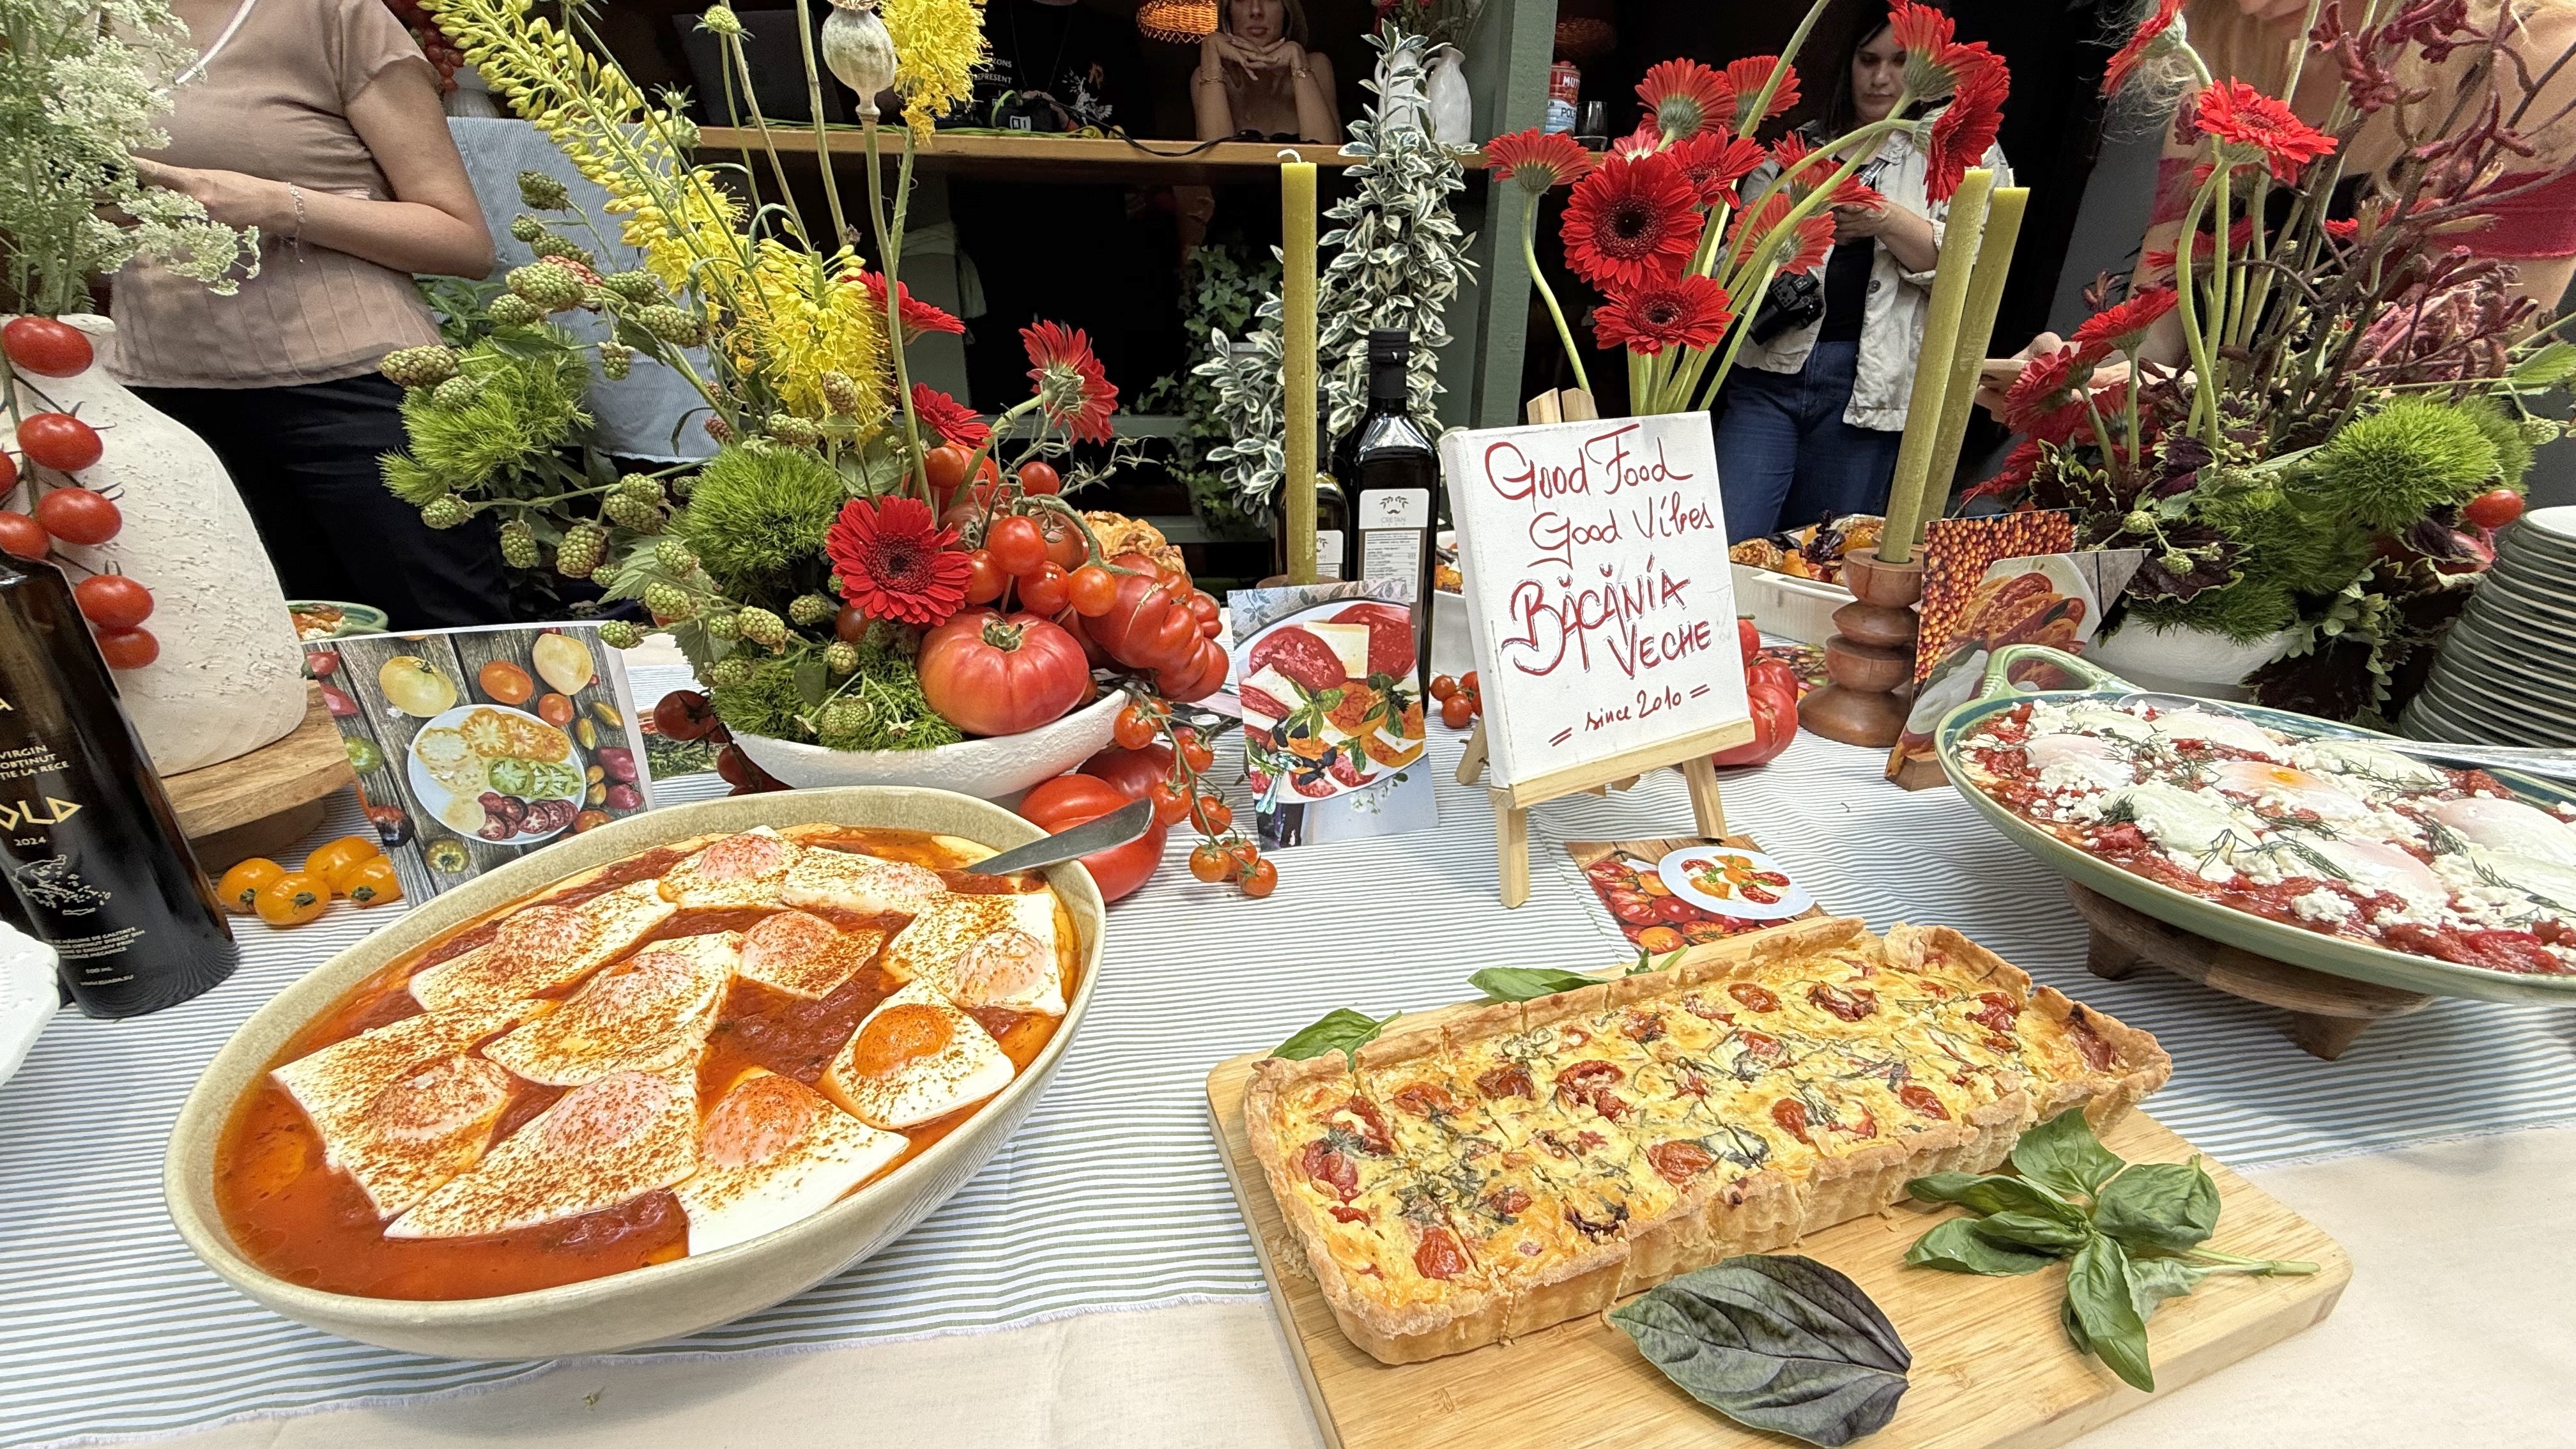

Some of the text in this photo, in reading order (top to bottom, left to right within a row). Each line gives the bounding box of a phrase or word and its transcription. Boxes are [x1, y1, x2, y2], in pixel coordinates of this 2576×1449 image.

[1485, 423, 1694, 513] Good Food
[1528, 491, 1715, 570] Good Vibes
[1603, 620, 1712, 680] VECHE
[1584, 684, 1682, 732] since 2010
[0, 744, 49, 760] VIRGIN
[40, 760, 70, 772] RECE
[13, 836, 47, 847] 2024
